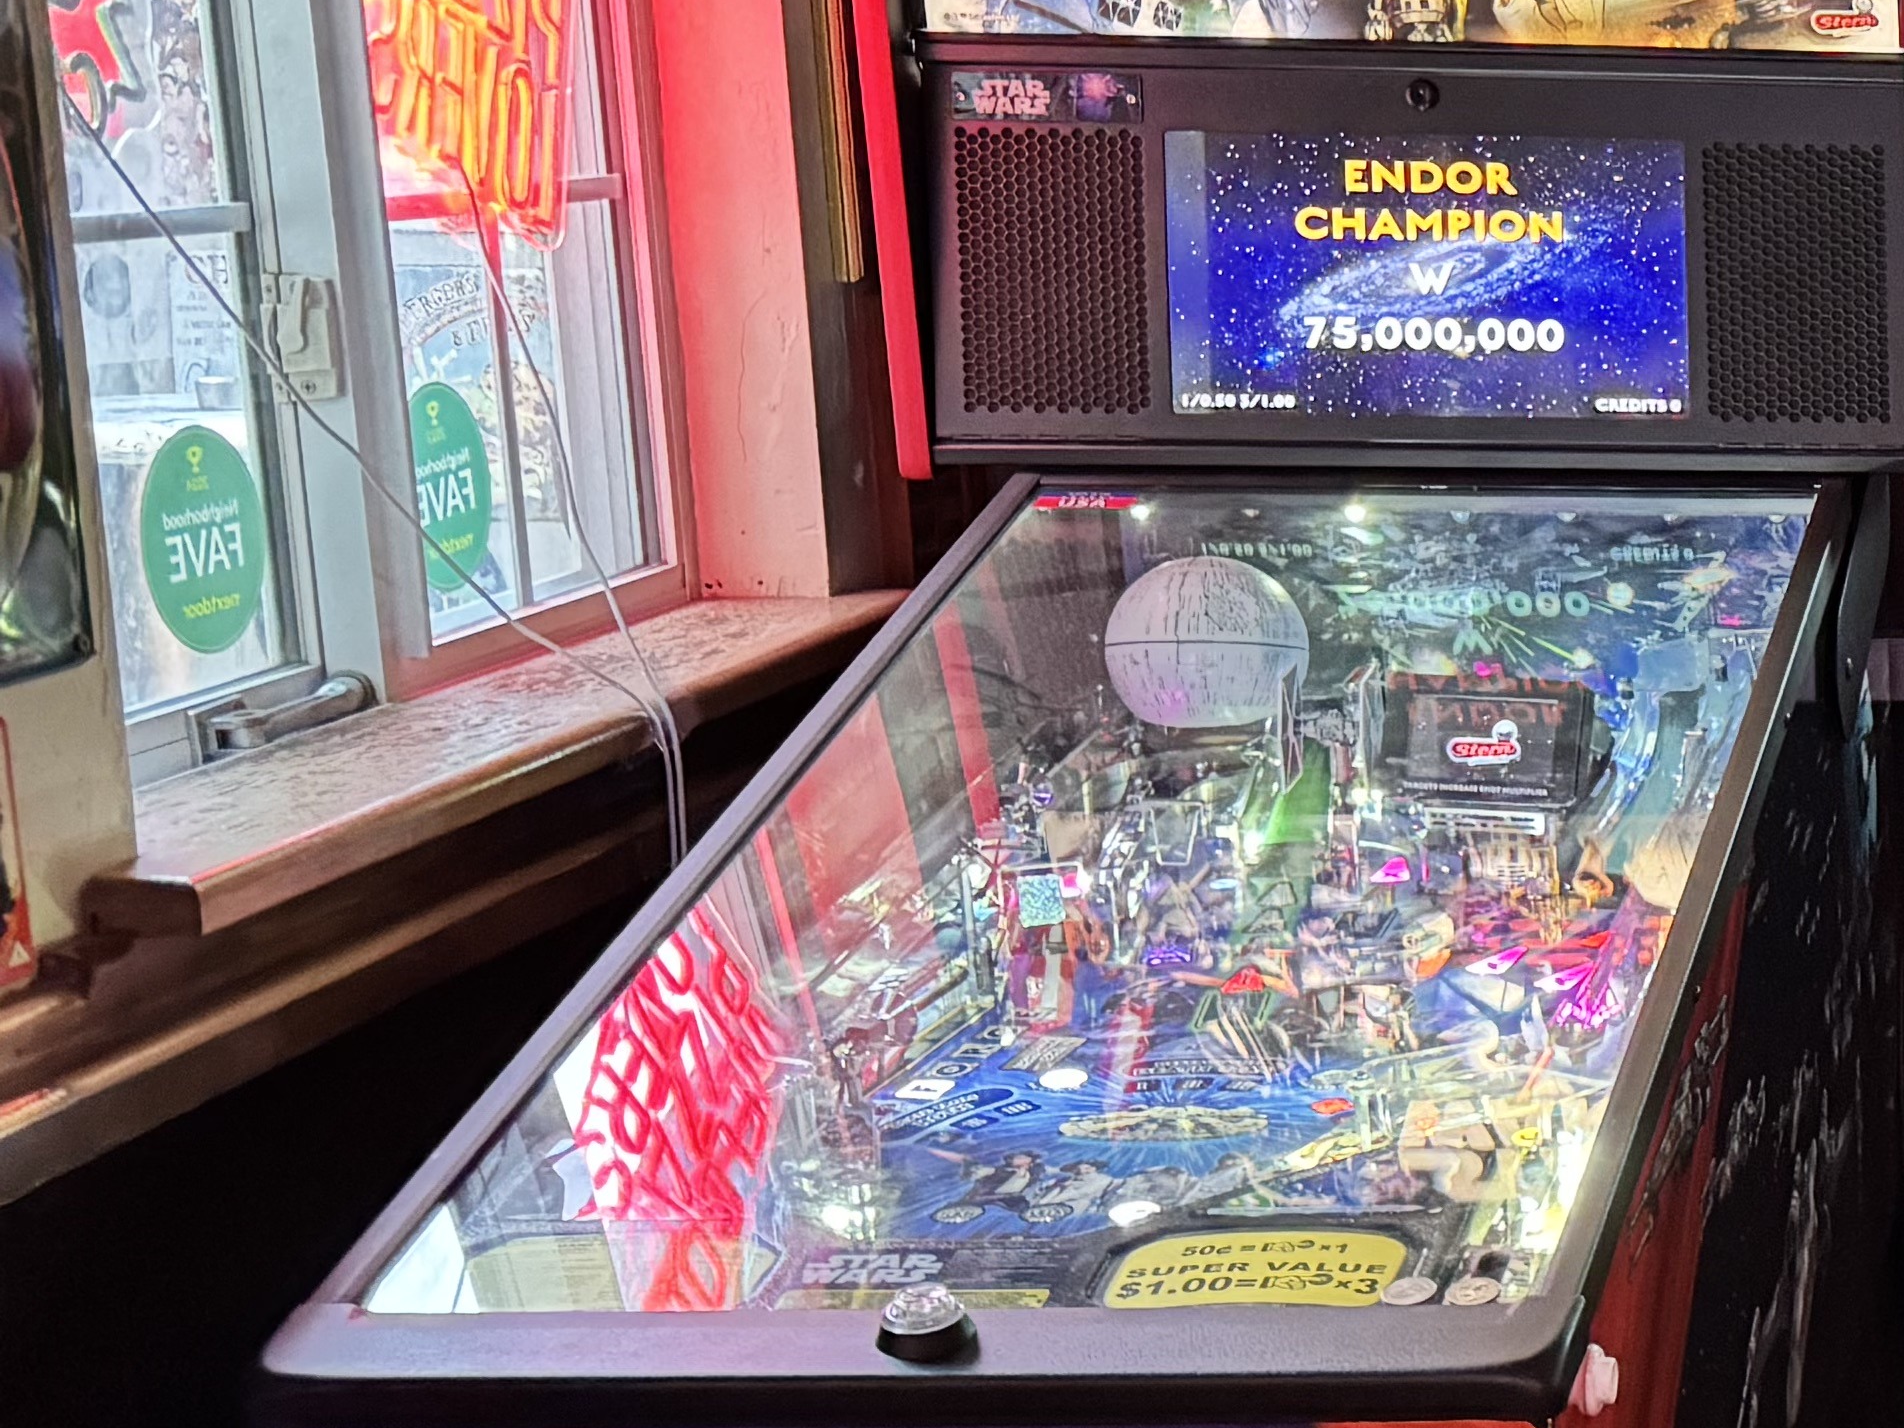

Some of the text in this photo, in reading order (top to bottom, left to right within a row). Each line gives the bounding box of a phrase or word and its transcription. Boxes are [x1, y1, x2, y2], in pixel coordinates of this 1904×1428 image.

[1818, 15, 1877, 29] Stern
[975, 78, 1050, 98] STAR
[975, 95, 1050, 116] WARS
[1343, 158, 1518, 197] ENDOR
[1293, 206, 1565, 244] CHAMPION
[1408, 262, 1453, 298] W
[1303, 316, 1565, 357] 75,000,000
[1594, 397, 1666, 413] CREDITS
[1453, 741, 1516, 757] Stern
[806, 1253, 944, 1270] STAR
[1126, 1260, 1388, 1278] SUPER VALUE
